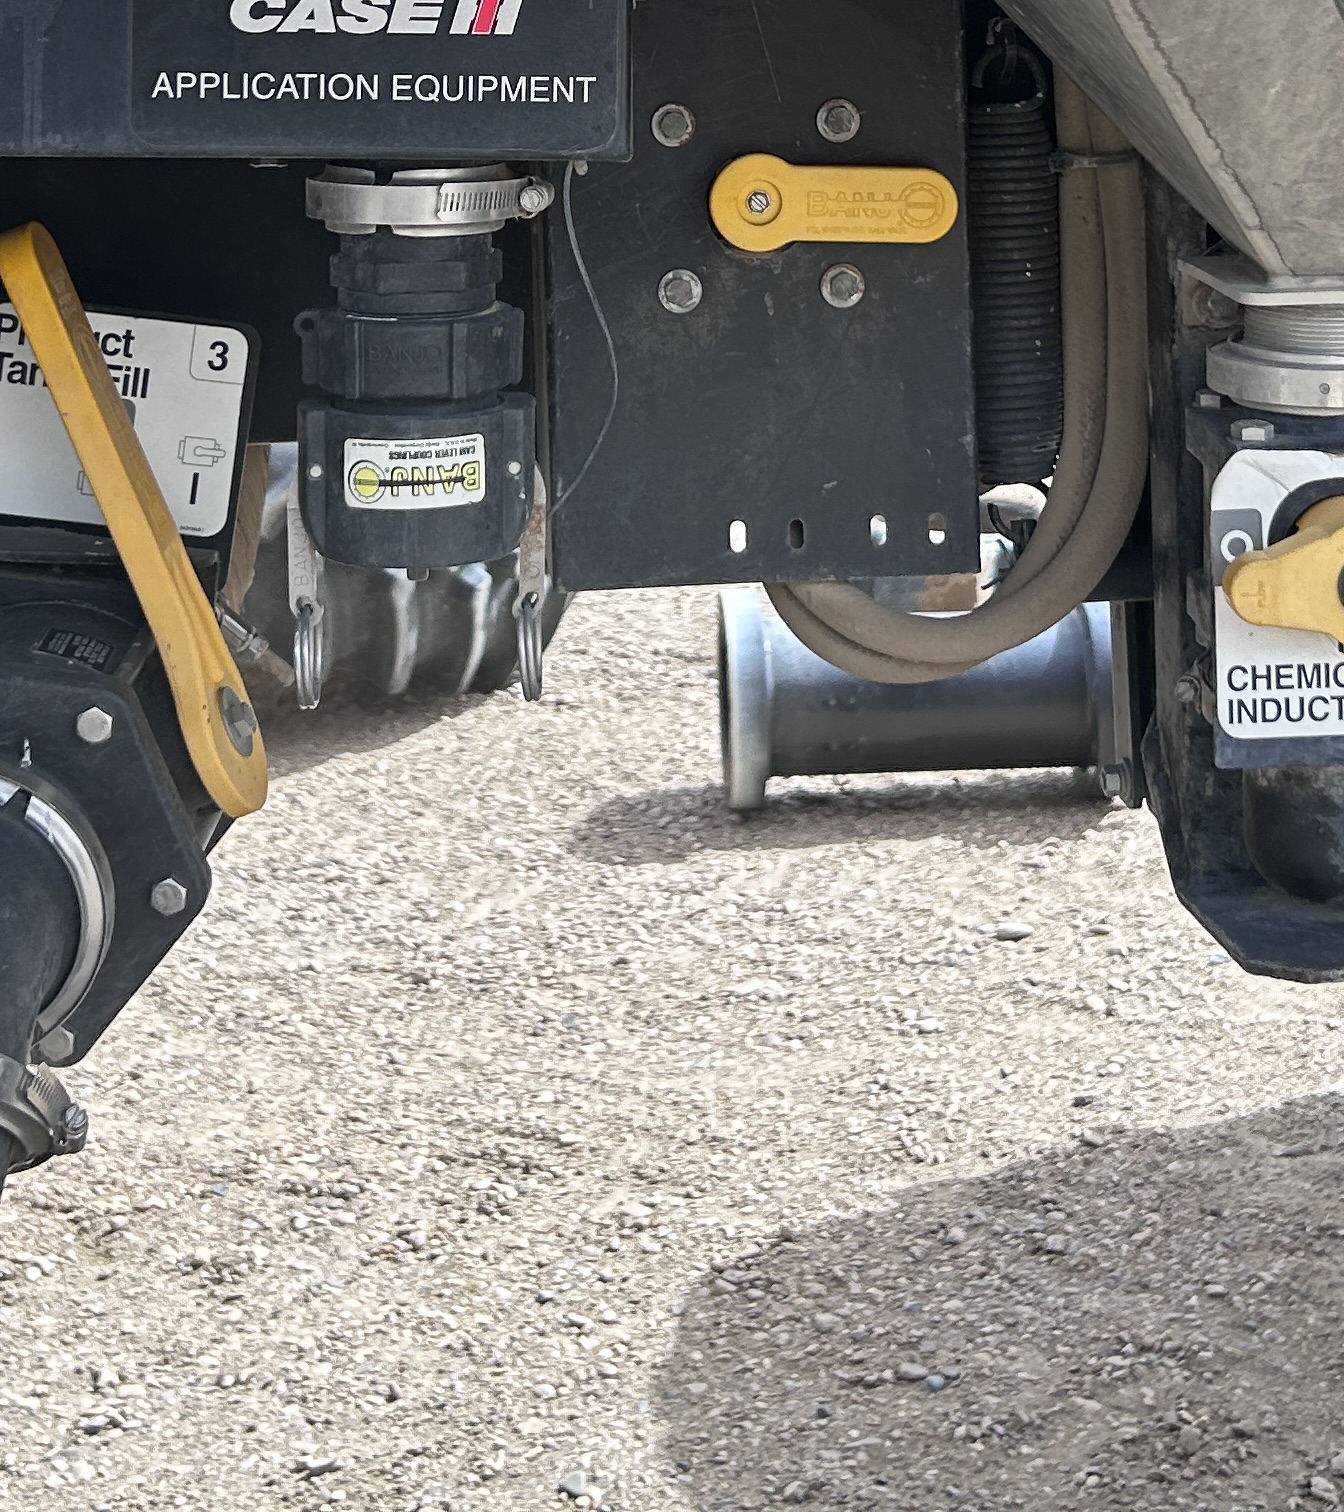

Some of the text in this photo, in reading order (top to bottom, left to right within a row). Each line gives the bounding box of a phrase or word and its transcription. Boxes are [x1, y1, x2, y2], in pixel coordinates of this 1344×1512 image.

[151, 72, 596, 103] APPLICATION EQUIPMENT
[207, 340, 229, 371] 3
